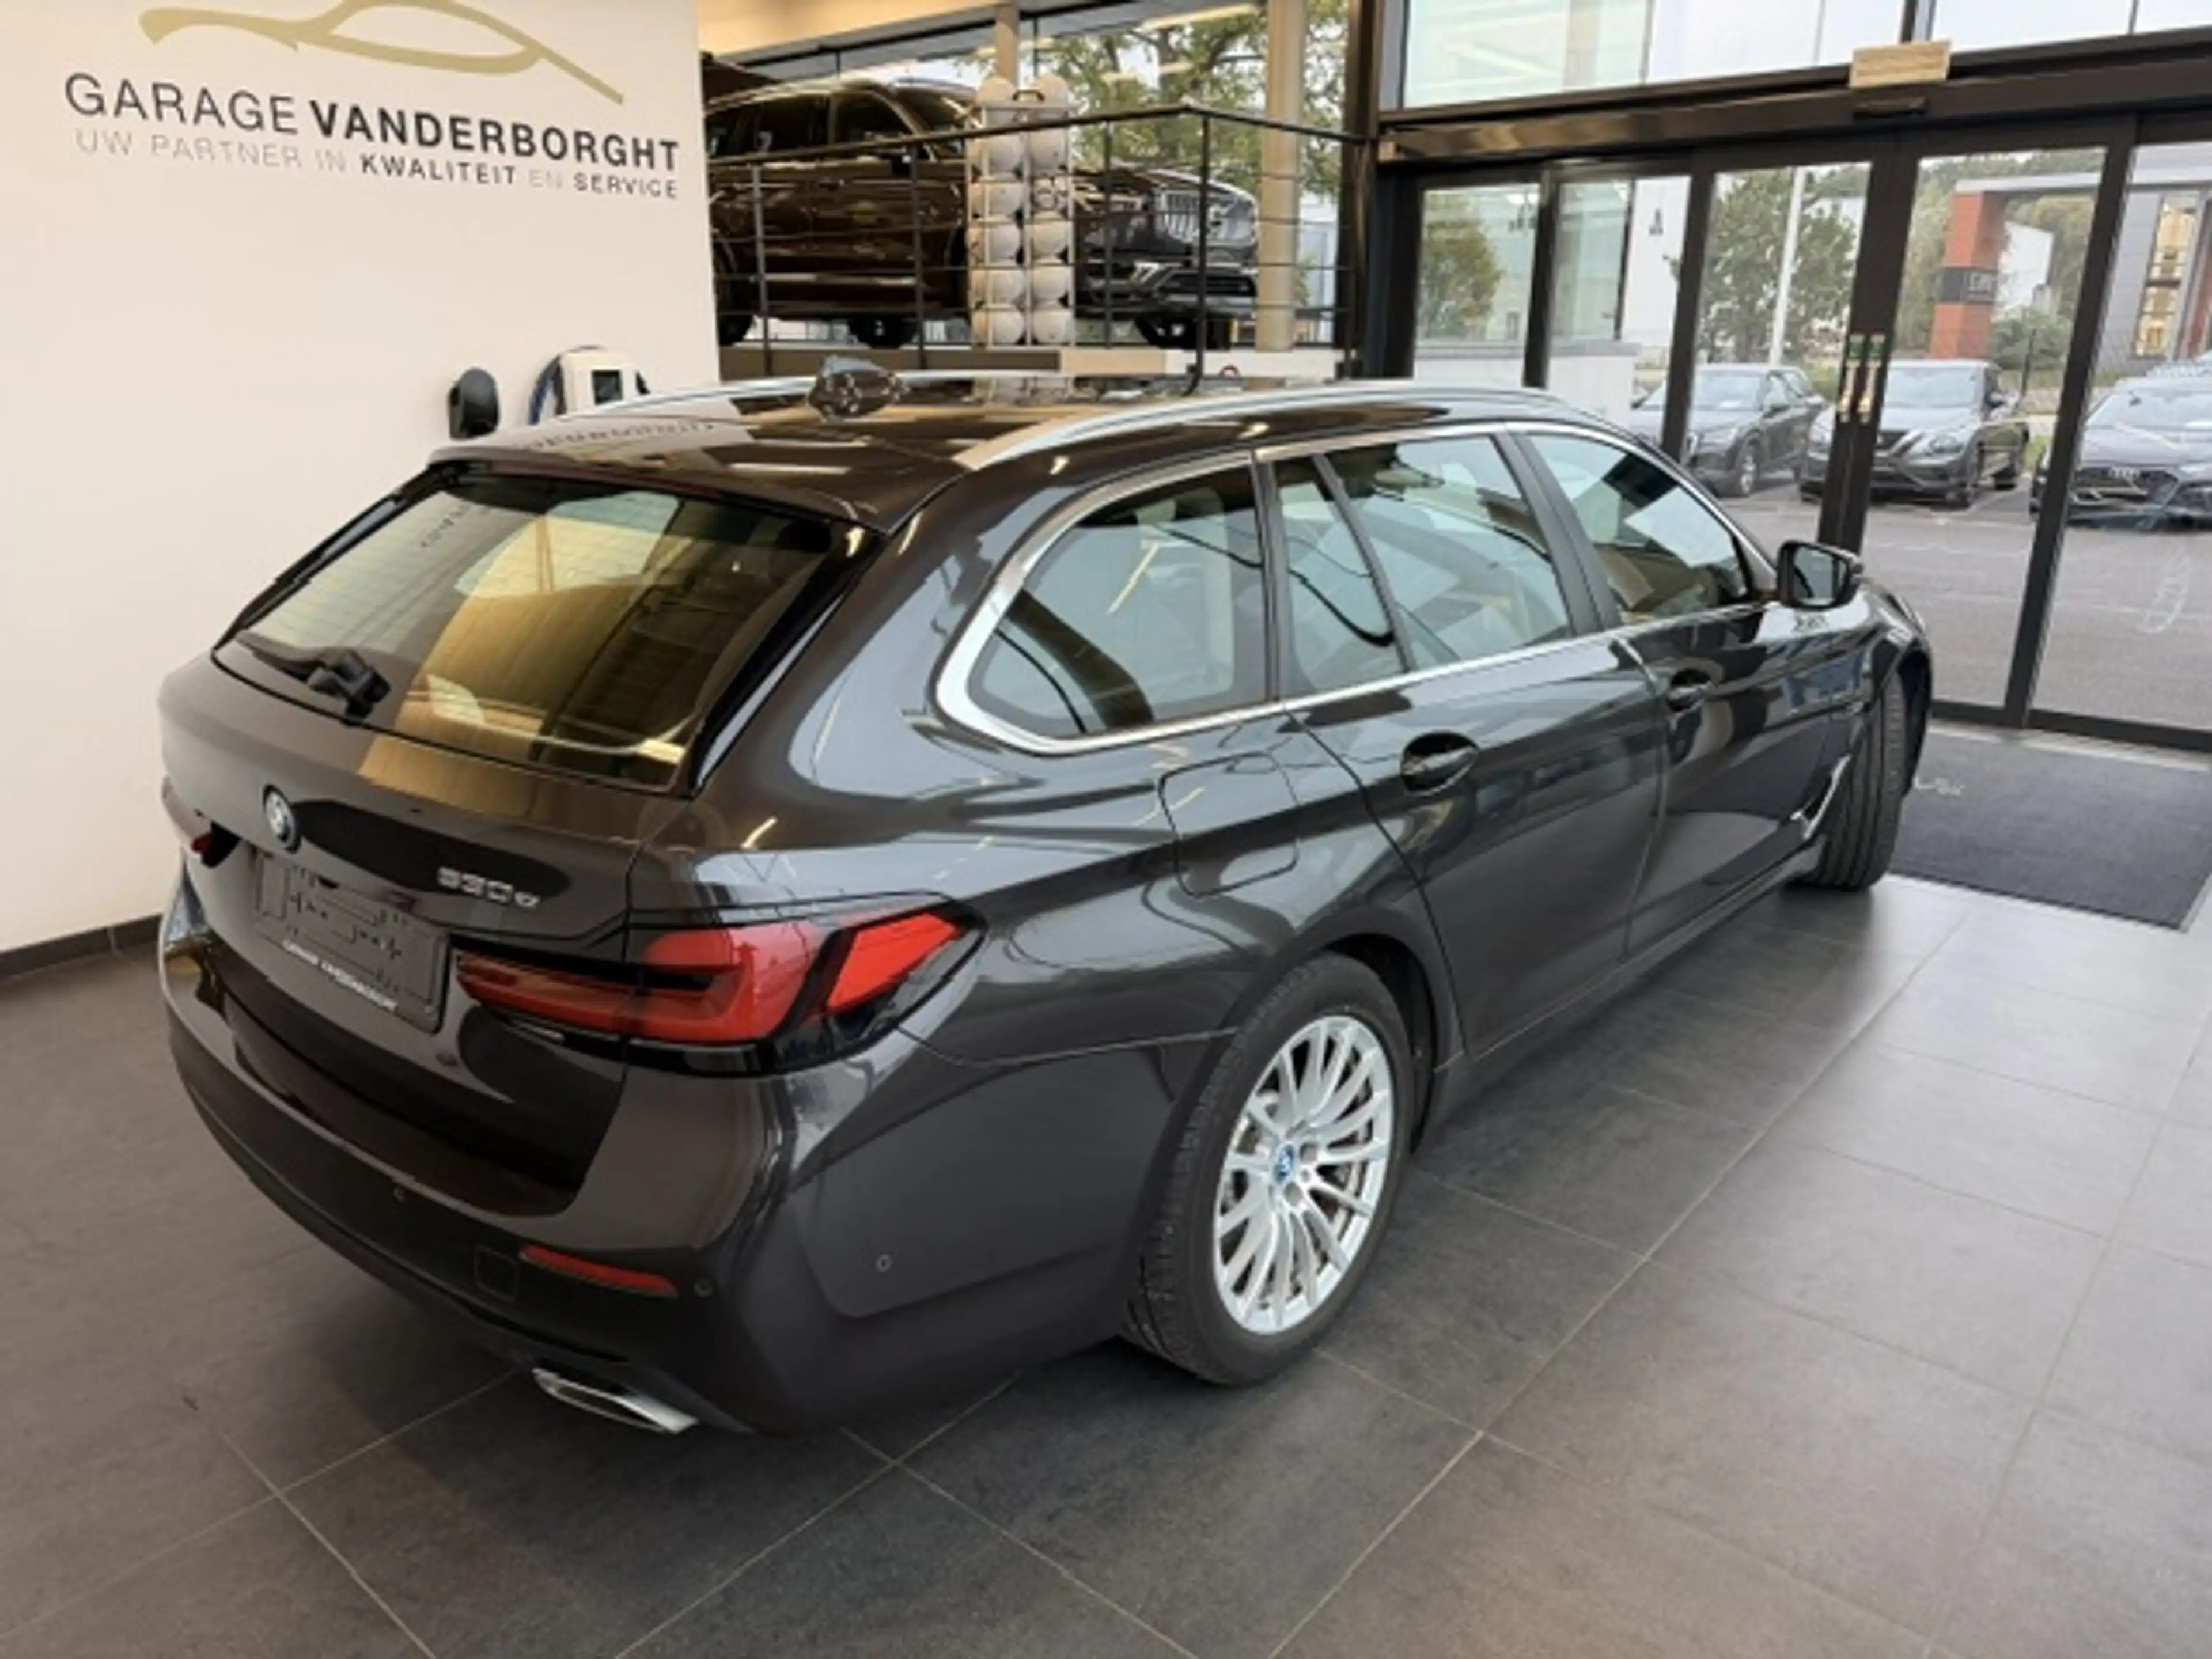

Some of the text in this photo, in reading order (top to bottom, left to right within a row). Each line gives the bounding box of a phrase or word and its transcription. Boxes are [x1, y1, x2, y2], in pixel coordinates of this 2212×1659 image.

[64, 71, 679, 171] GARAGE VANDERBORGHT
[75, 127, 679, 200] UW PARTNER IN KWALITEIT EN SERVICE
